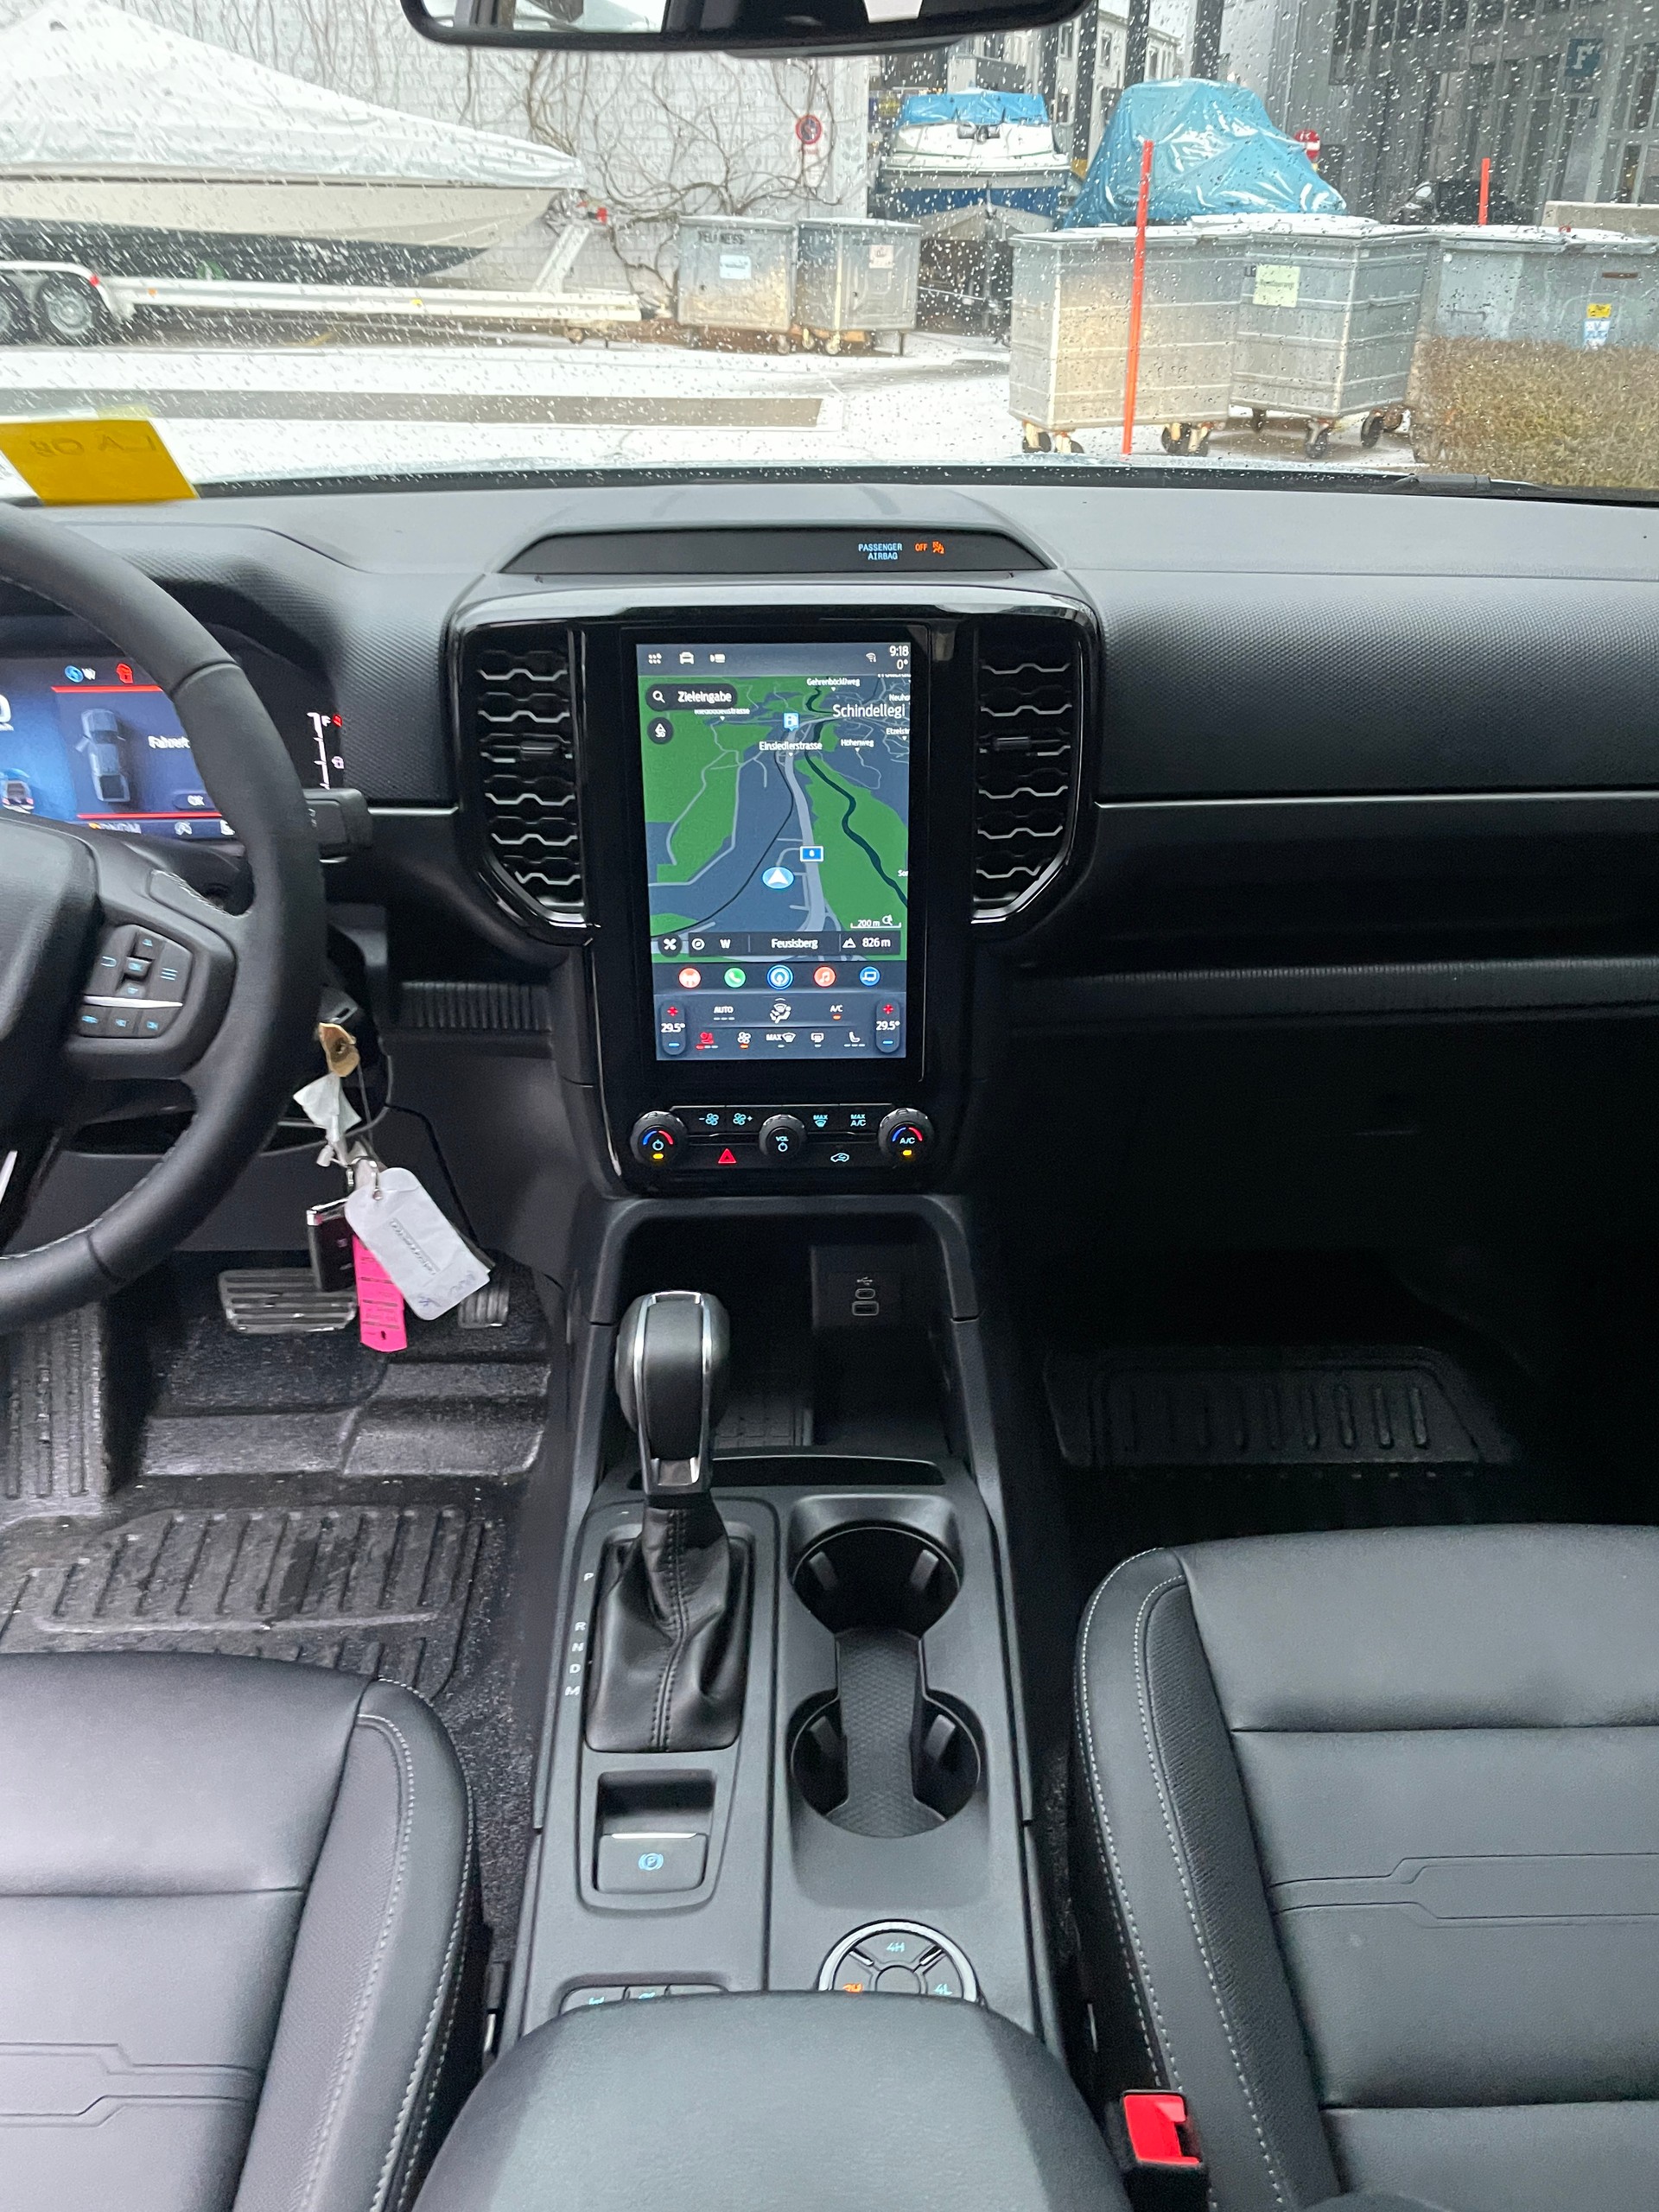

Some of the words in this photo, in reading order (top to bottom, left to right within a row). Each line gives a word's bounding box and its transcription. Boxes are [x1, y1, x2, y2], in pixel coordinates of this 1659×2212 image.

[858, 543, 903, 552] PASSENGER
[914, 543, 929, 552] OFF
[868, 552, 898, 561] AIRBAG
[889, 645, 909, 657] 9:18
[677, 690, 733, 704] Zieleingabe
[832, 703, 906, 719] Schindellegi
[759, 741, 823, 751] Einsiedlerstrasse
[771, 938, 818, 950] Feusisberg
[861, 938, 880, 948] 826
[880, 939, 891, 948] m
[713, 1006, 734, 1014] AUTO
[830, 1004, 843, 1013] A/C
[583, 1572, 594, 1582] P
[575, 1621, 587, 1631] R
[571, 1642, 584, 1652] N
[569, 1663, 582, 1674] D
[564, 1686, 581, 1696] M
[886, 1942, 906, 1952] 4H
[933, 1983, 953, 1996] 4L
